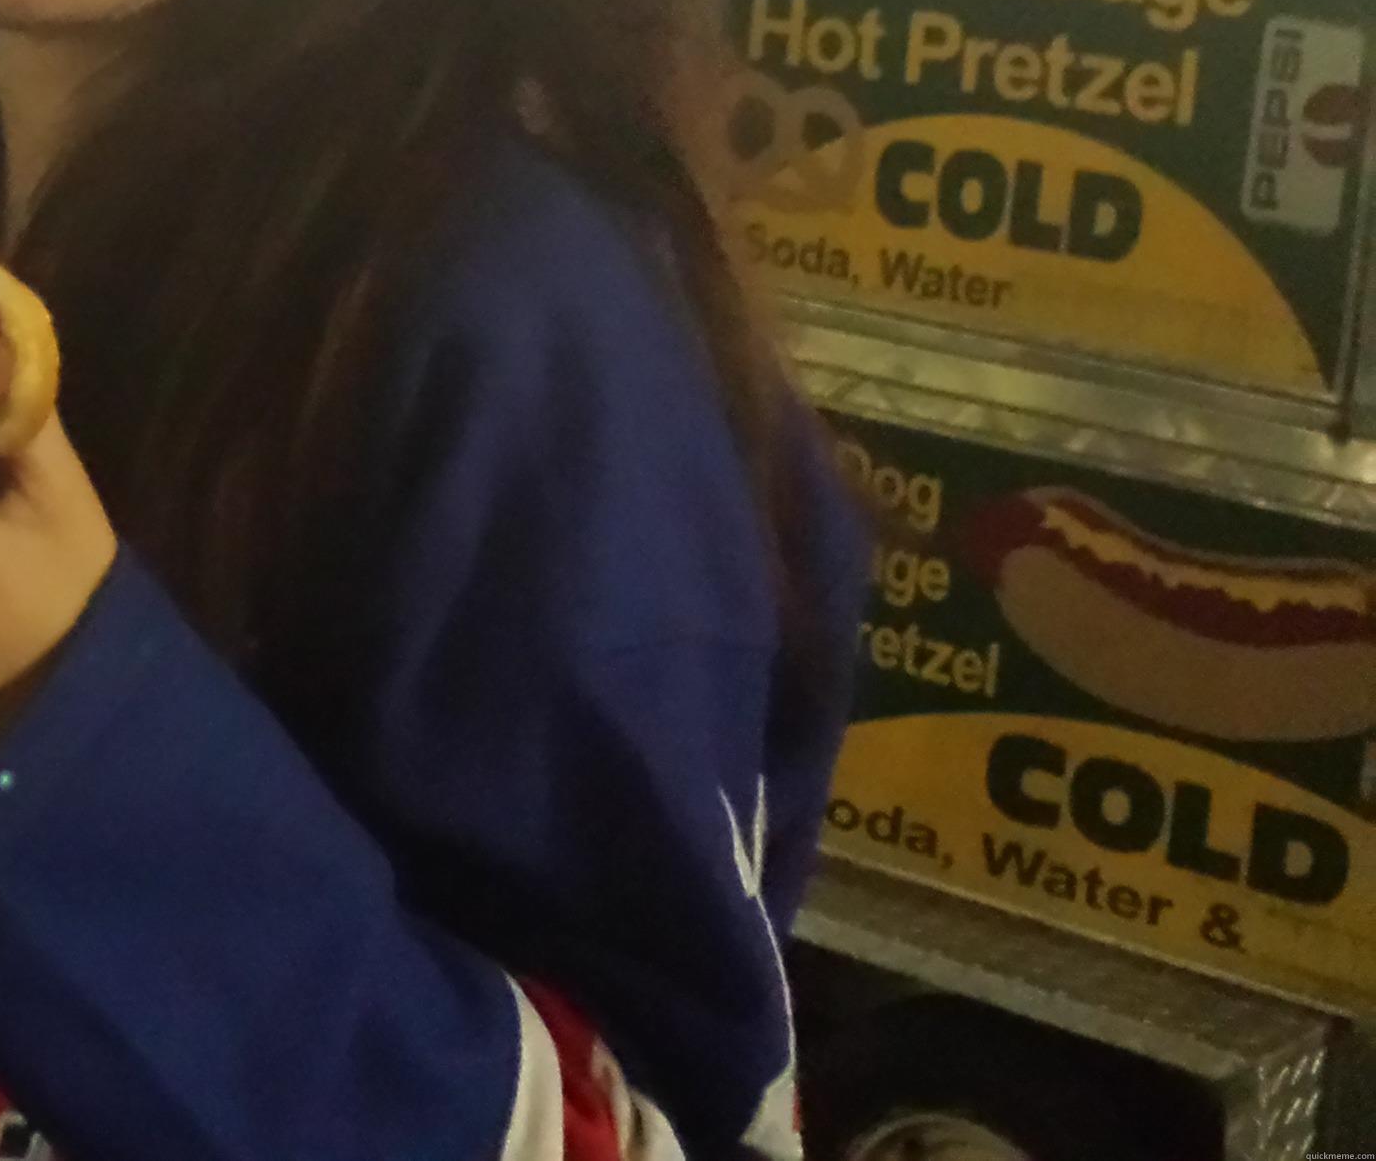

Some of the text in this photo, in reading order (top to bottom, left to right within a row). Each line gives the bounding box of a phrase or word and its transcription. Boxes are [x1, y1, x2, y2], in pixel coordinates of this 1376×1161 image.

[904, 9, 1200, 127] Pretzel
[1248, 27, 1303, 212] PEPSI
[874, 139, 1144, 264] COLD
[878, 246, 1014, 309] Water
[824, 797, 1247, 955] oda, Water &
[984, 733, 1351, 908] COLD
